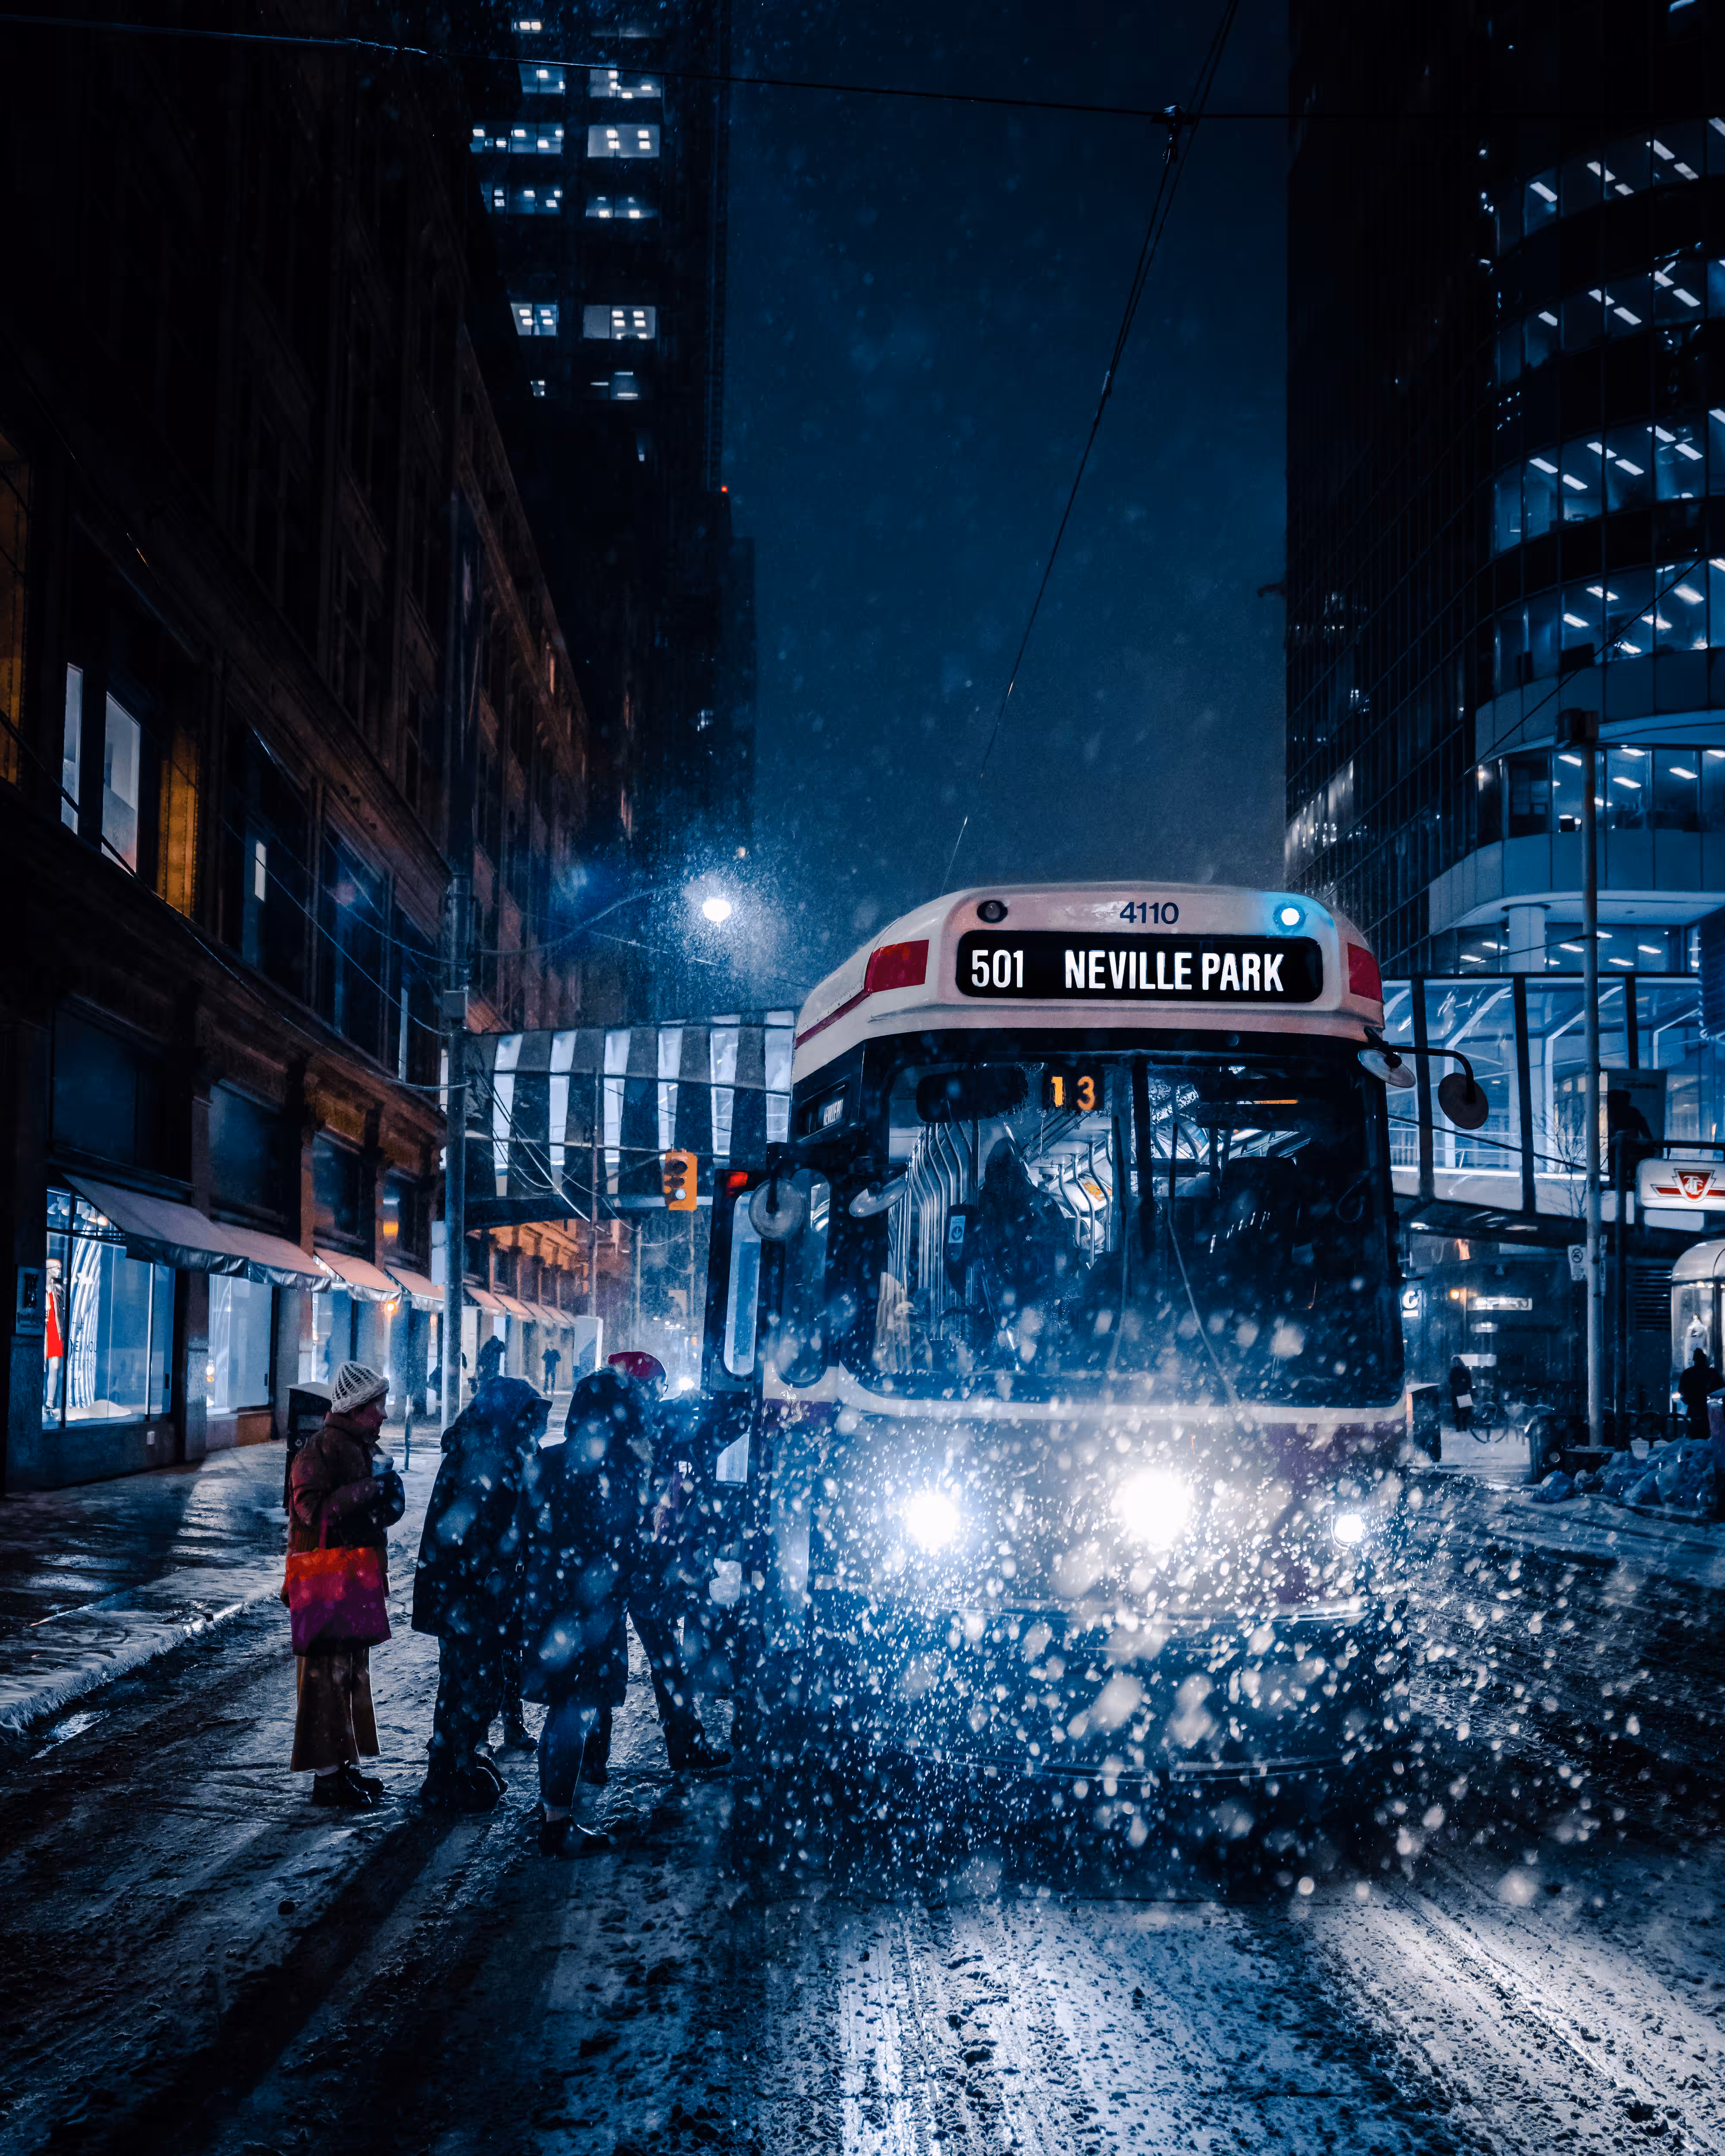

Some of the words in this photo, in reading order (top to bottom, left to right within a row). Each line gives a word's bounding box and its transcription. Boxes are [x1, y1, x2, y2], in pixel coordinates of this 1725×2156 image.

[1120, 902, 1179, 924] 4110
[972, 950, 1023, 987] 501
[1066, 950, 1192, 990] NEVILLE
[1202, 953, 1283, 991] PARK
